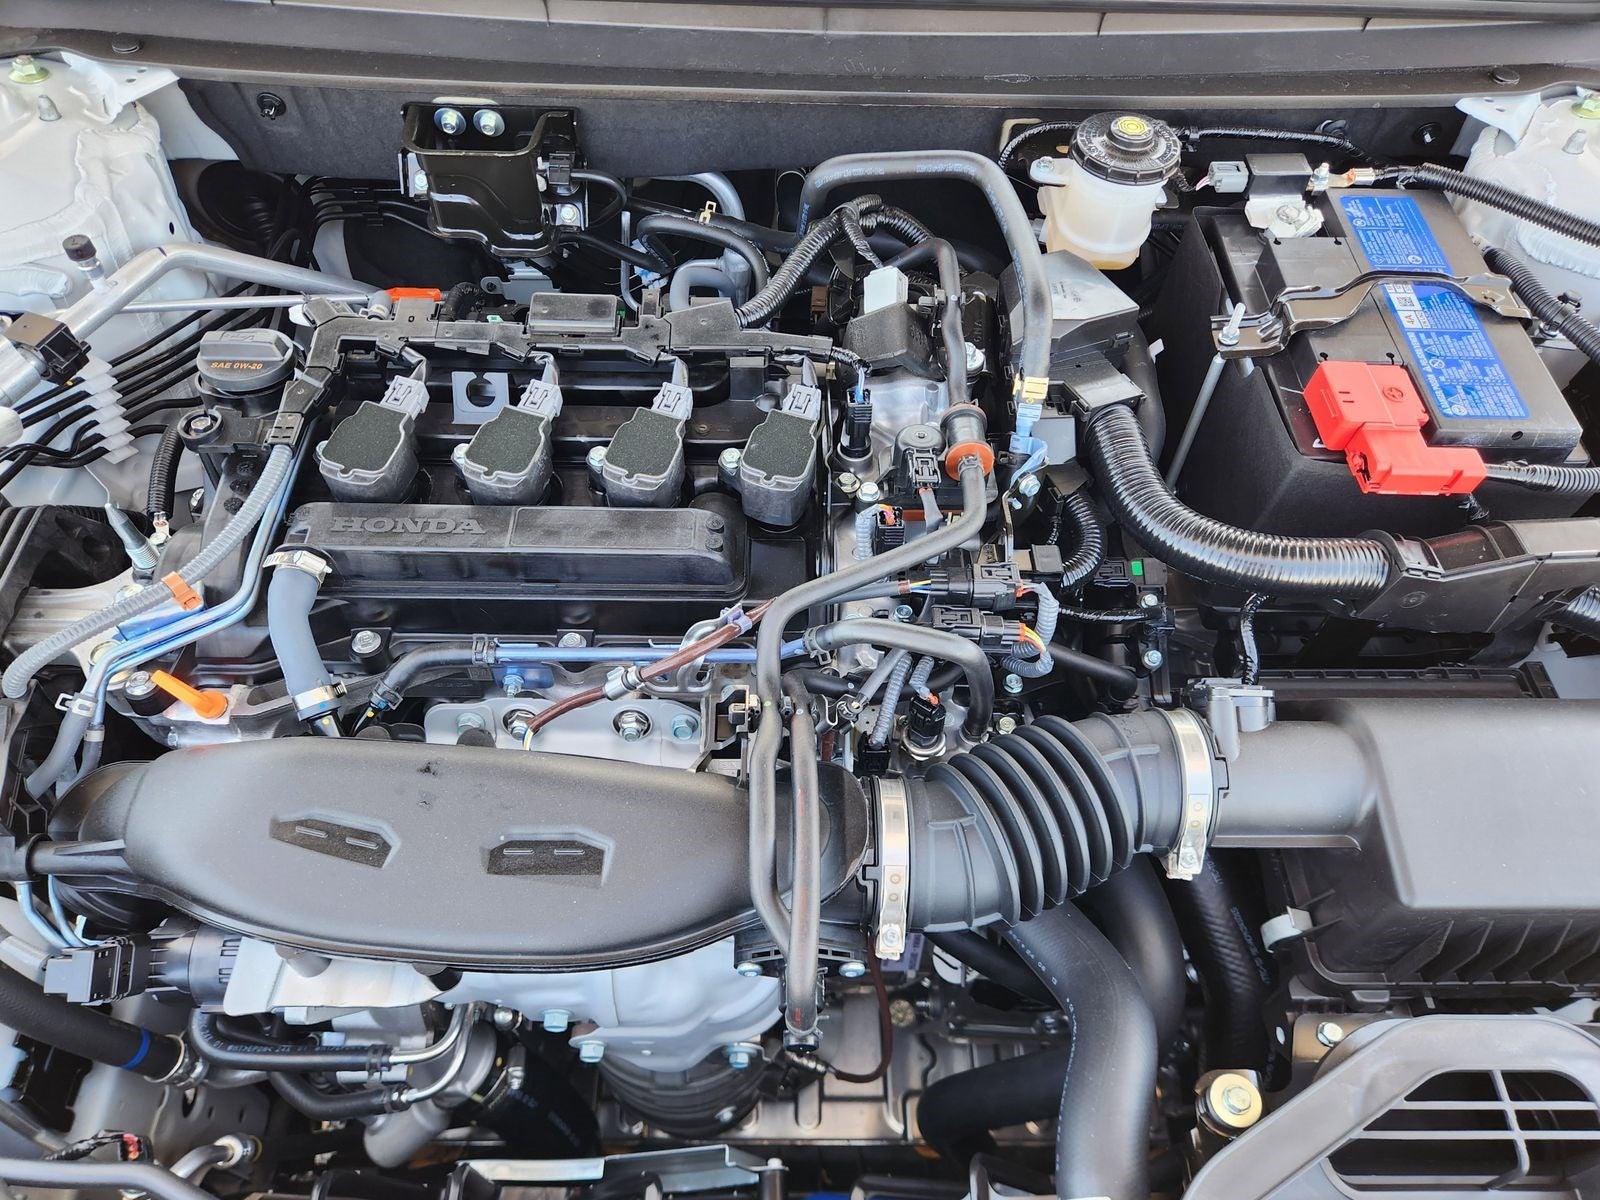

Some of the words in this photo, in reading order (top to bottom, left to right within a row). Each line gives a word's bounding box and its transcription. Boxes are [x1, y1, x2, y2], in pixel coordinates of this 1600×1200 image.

[210, 361, 232, 369] SAE
[233, 362, 264, 370] 0W-20
[330, 516, 487, 535] HONDA
